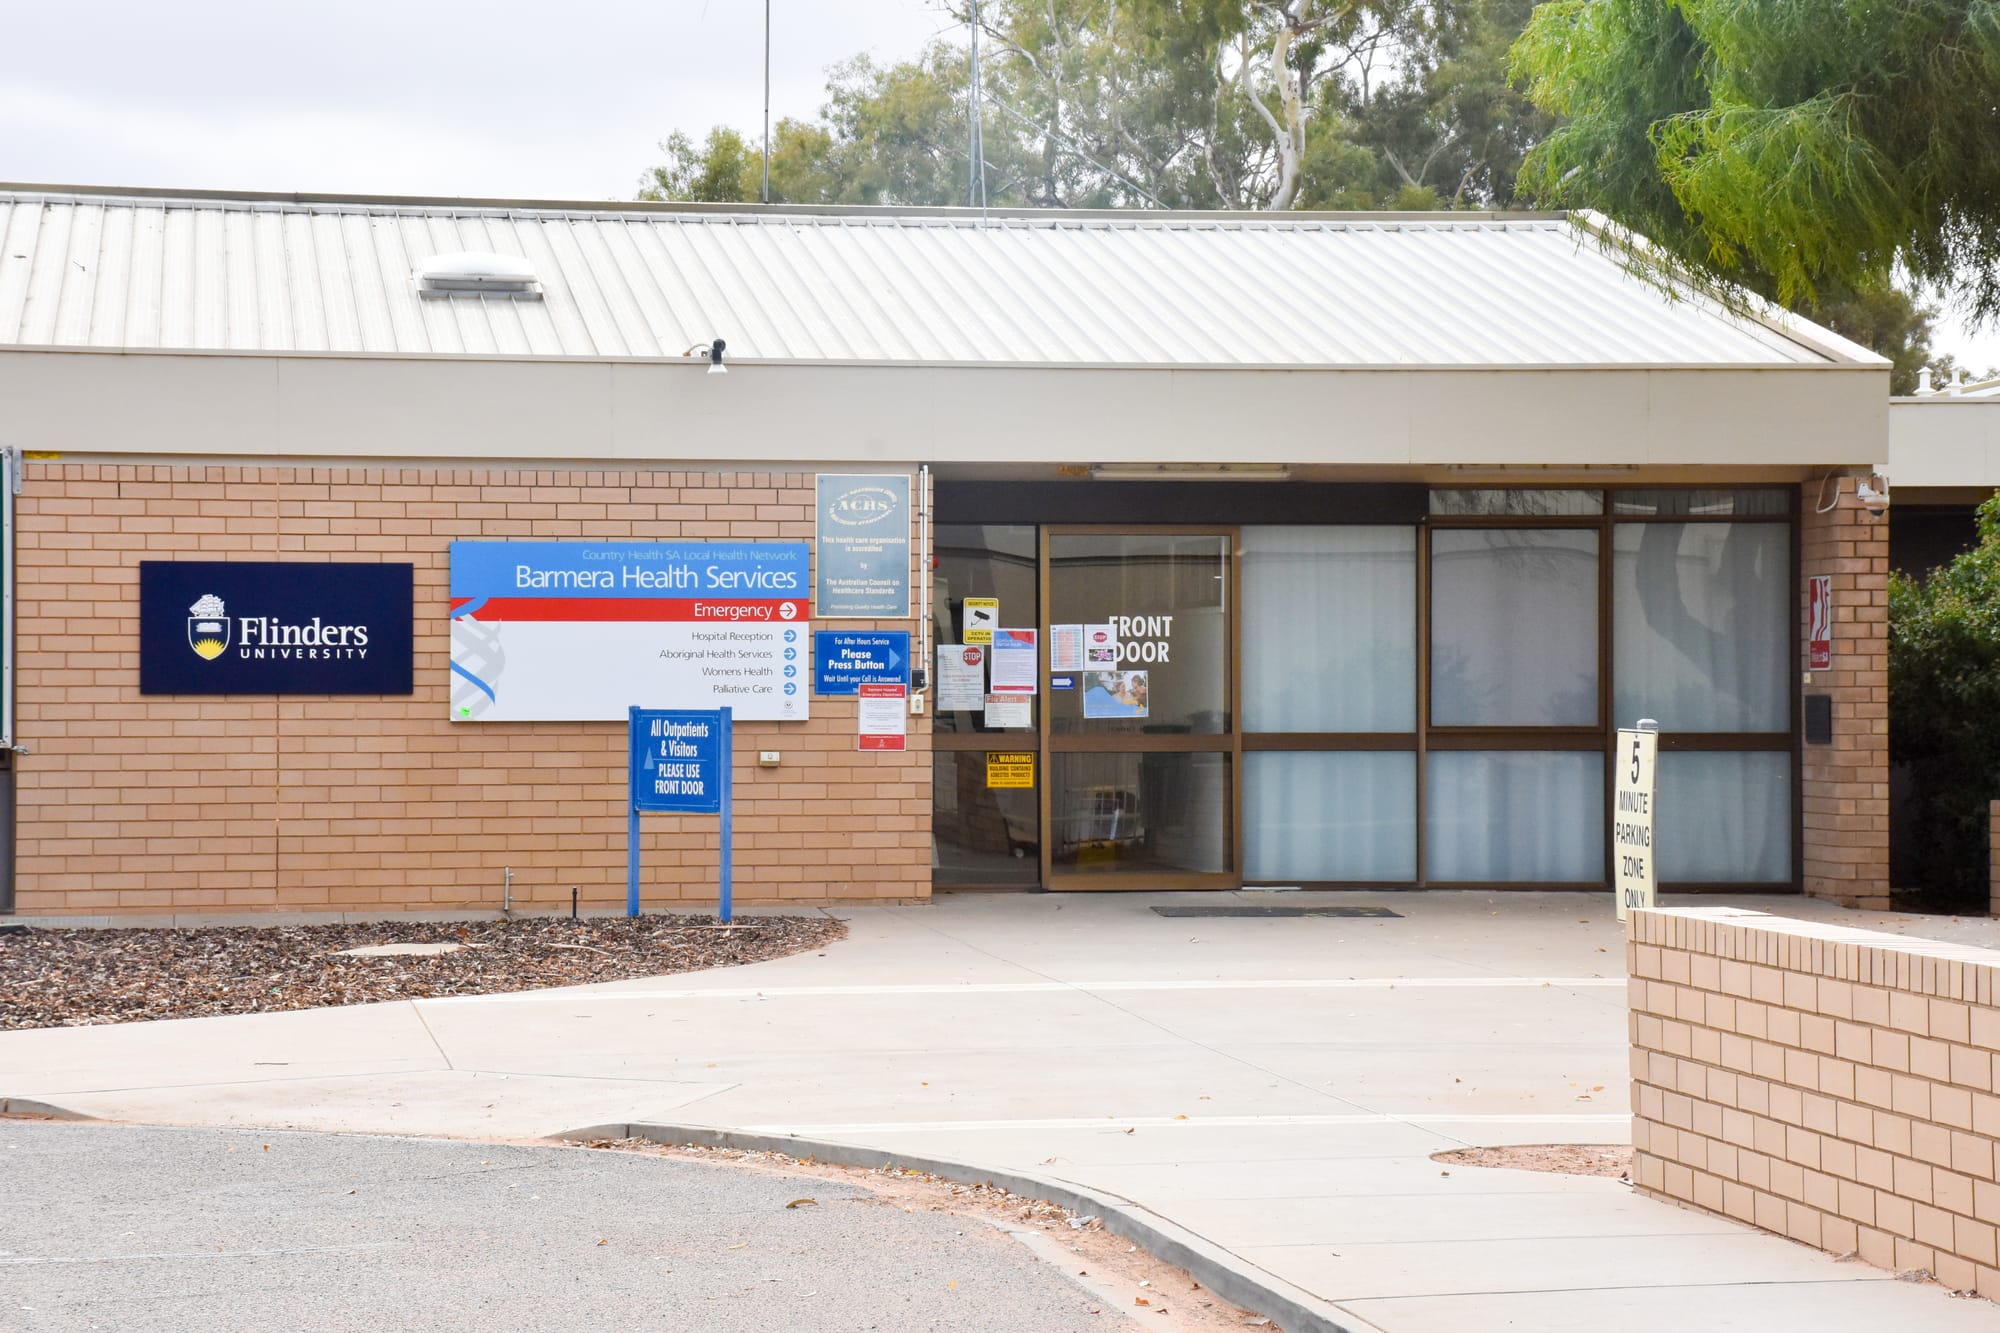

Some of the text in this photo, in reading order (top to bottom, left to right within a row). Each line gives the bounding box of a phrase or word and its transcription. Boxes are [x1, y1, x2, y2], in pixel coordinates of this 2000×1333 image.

[838, 500, 888, 511] ACHS
[582, 549, 797, 562] Country Health SA Local Health Network
[860, 562, 868, 570] by
[516, 563, 797, 590] Barmera Health Services
[826, 578, 837, 586] The
[838, 578, 868, 586] Australian
[869, 578, 891, 586] Council
[694, 602, 773, 621] Emergency
[238, 616, 369, 646] Flinders
[691, 631, 773, 643] Hospital Reception
[834, 637, 890, 646] For After Hours Service
[240, 648, 368, 660] UNIVERSITY
[659, 648, 773, 661] Aboriginal Health Services
[841, 648, 872, 659] Please
[964, 651, 980, 661] STOP
[1117, 641, 1170, 662] DOOR
[702, 666, 773, 676] Womens Health
[828, 660, 885, 669] Press Button
[850, 676, 860, 684] your
[877, 675, 901, 683] Answered
[713, 684, 773, 694] Palliative Care
[650, 718, 709, 741] All Outpatients
[660, 740, 698, 757] & Visitors
[999, 754, 1031, 763] WARNING
[1631, 741, 1640, 785] 5
[658, 763, 700, 778] PLEASE USE
[655, 780, 704, 795] FRONT DOOR
[1619, 790, 1648, 815] MINUTE
[1616, 822, 1650, 847] PARKING
[1622, 856, 1644, 879] ZONE
[1624, 887, 1645, 908] ONLY
